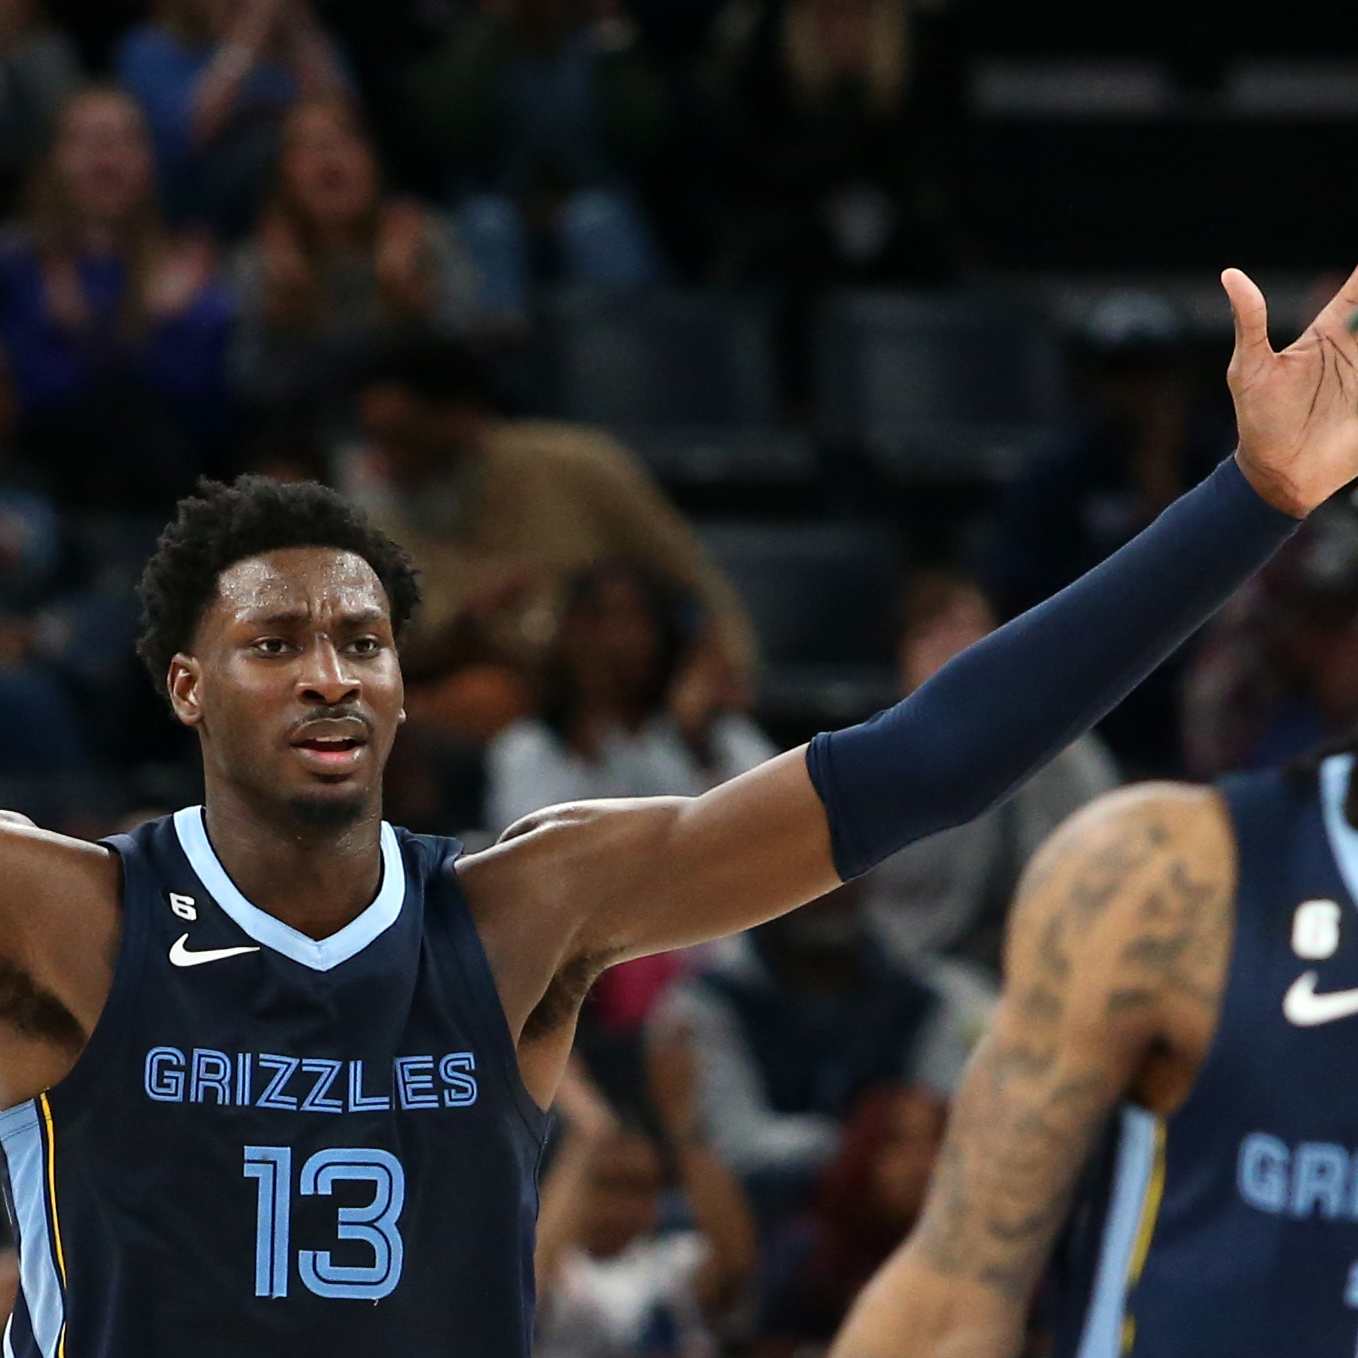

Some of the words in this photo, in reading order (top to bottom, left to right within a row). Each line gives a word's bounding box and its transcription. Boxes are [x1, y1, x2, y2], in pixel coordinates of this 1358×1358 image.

[169, 892, 197, 921] 6
[143, 1045, 479, 1114] GRIZZLES
[243, 1145, 406, 1300] 13
